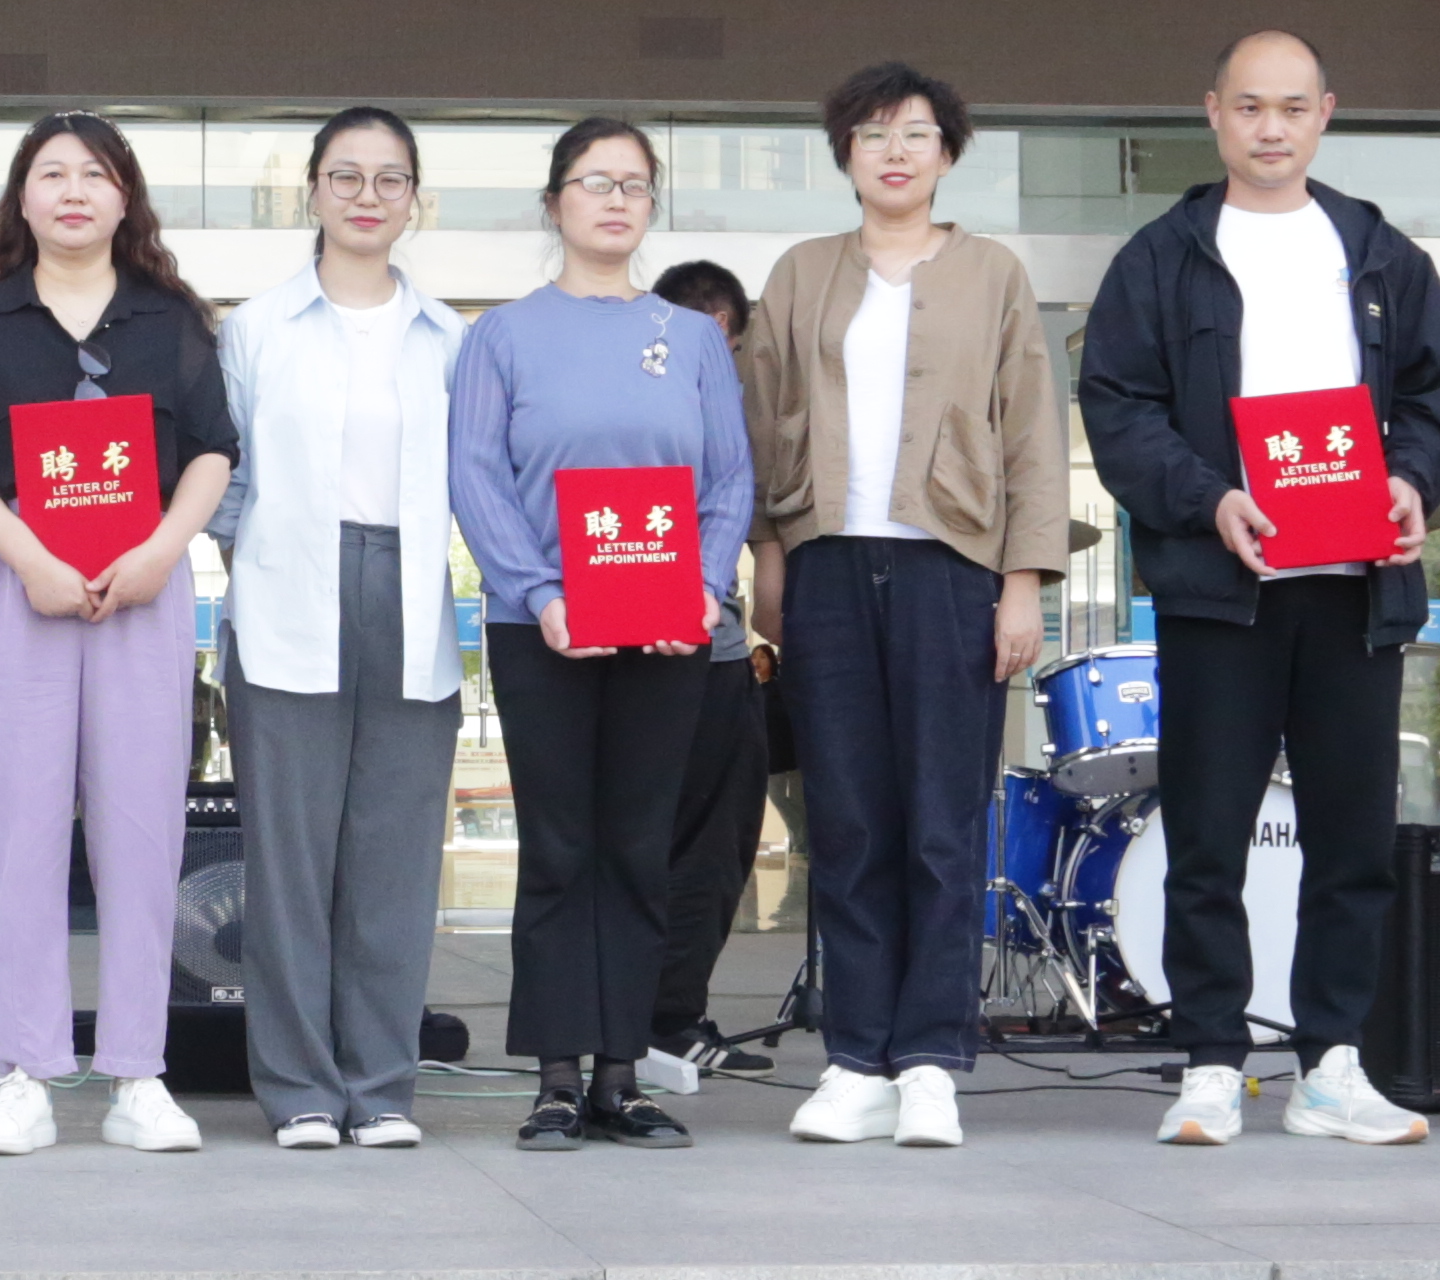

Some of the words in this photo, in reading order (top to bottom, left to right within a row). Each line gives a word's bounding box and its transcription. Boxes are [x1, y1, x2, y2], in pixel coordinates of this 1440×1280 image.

[1265, 425, 1354, 463] 聘书
[40, 441, 130, 481] 聘书
[1281, 463, 1328, 476] LETTER
[1330, 460, 1346, 471] OF
[53, 482, 100, 495] LETTER
[103, 480, 119, 491] OF
[1275, 470, 1360, 488] APPOINTMENT
[45, 492, 133, 509] APPOINTMENT
[584, 506, 673, 540] 聘书
[597, 542, 644, 553] LETTER
[647, 541, 663, 551] OF
[589, 552, 677, 564] APPOINTMENT
